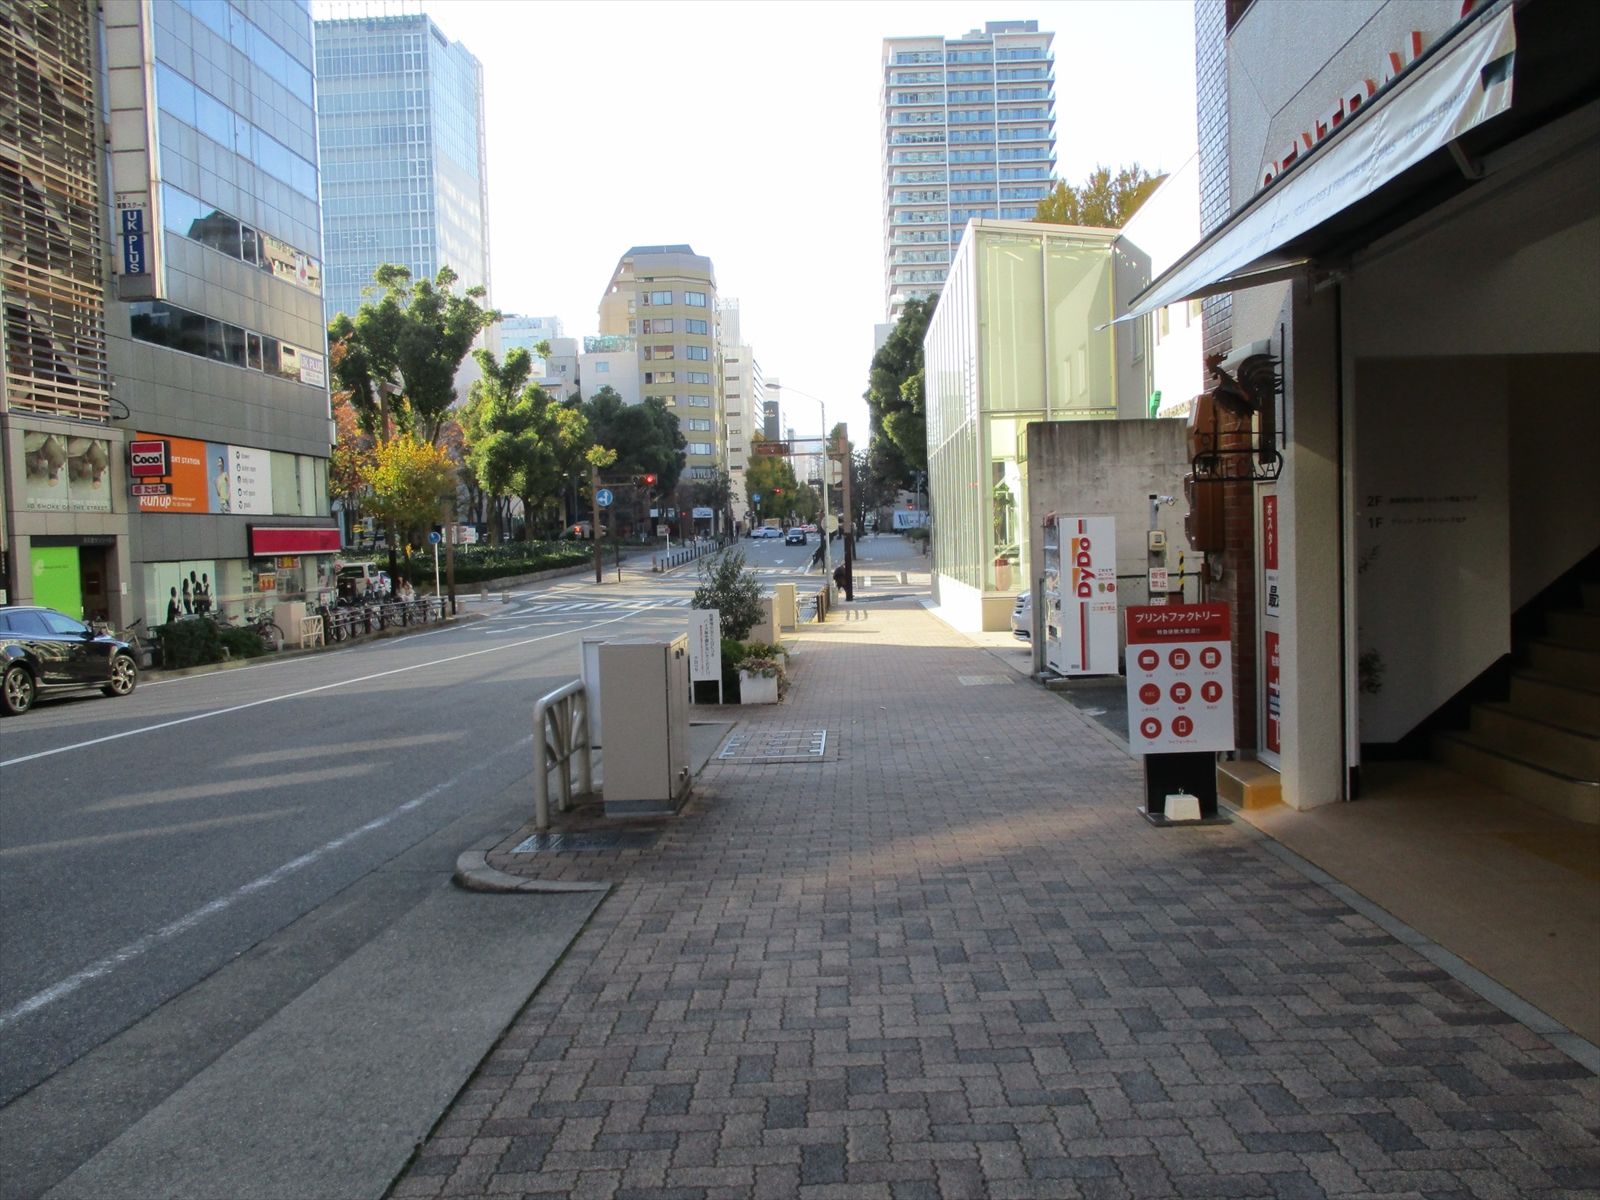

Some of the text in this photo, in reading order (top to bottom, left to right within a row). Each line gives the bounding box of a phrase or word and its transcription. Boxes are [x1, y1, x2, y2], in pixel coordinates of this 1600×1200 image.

[127, 211, 140, 273] UK PLUS
[132, 454, 162, 464] Coco!
[182, 456, 201, 465] STATION
[1367, 496, 1382, 507] 2F
[1368, 516, 1384, 528] 1F
[1152, 580, 1166, 588] 禁止
[1136, 611, 1221, 623] プリントファクトリー
